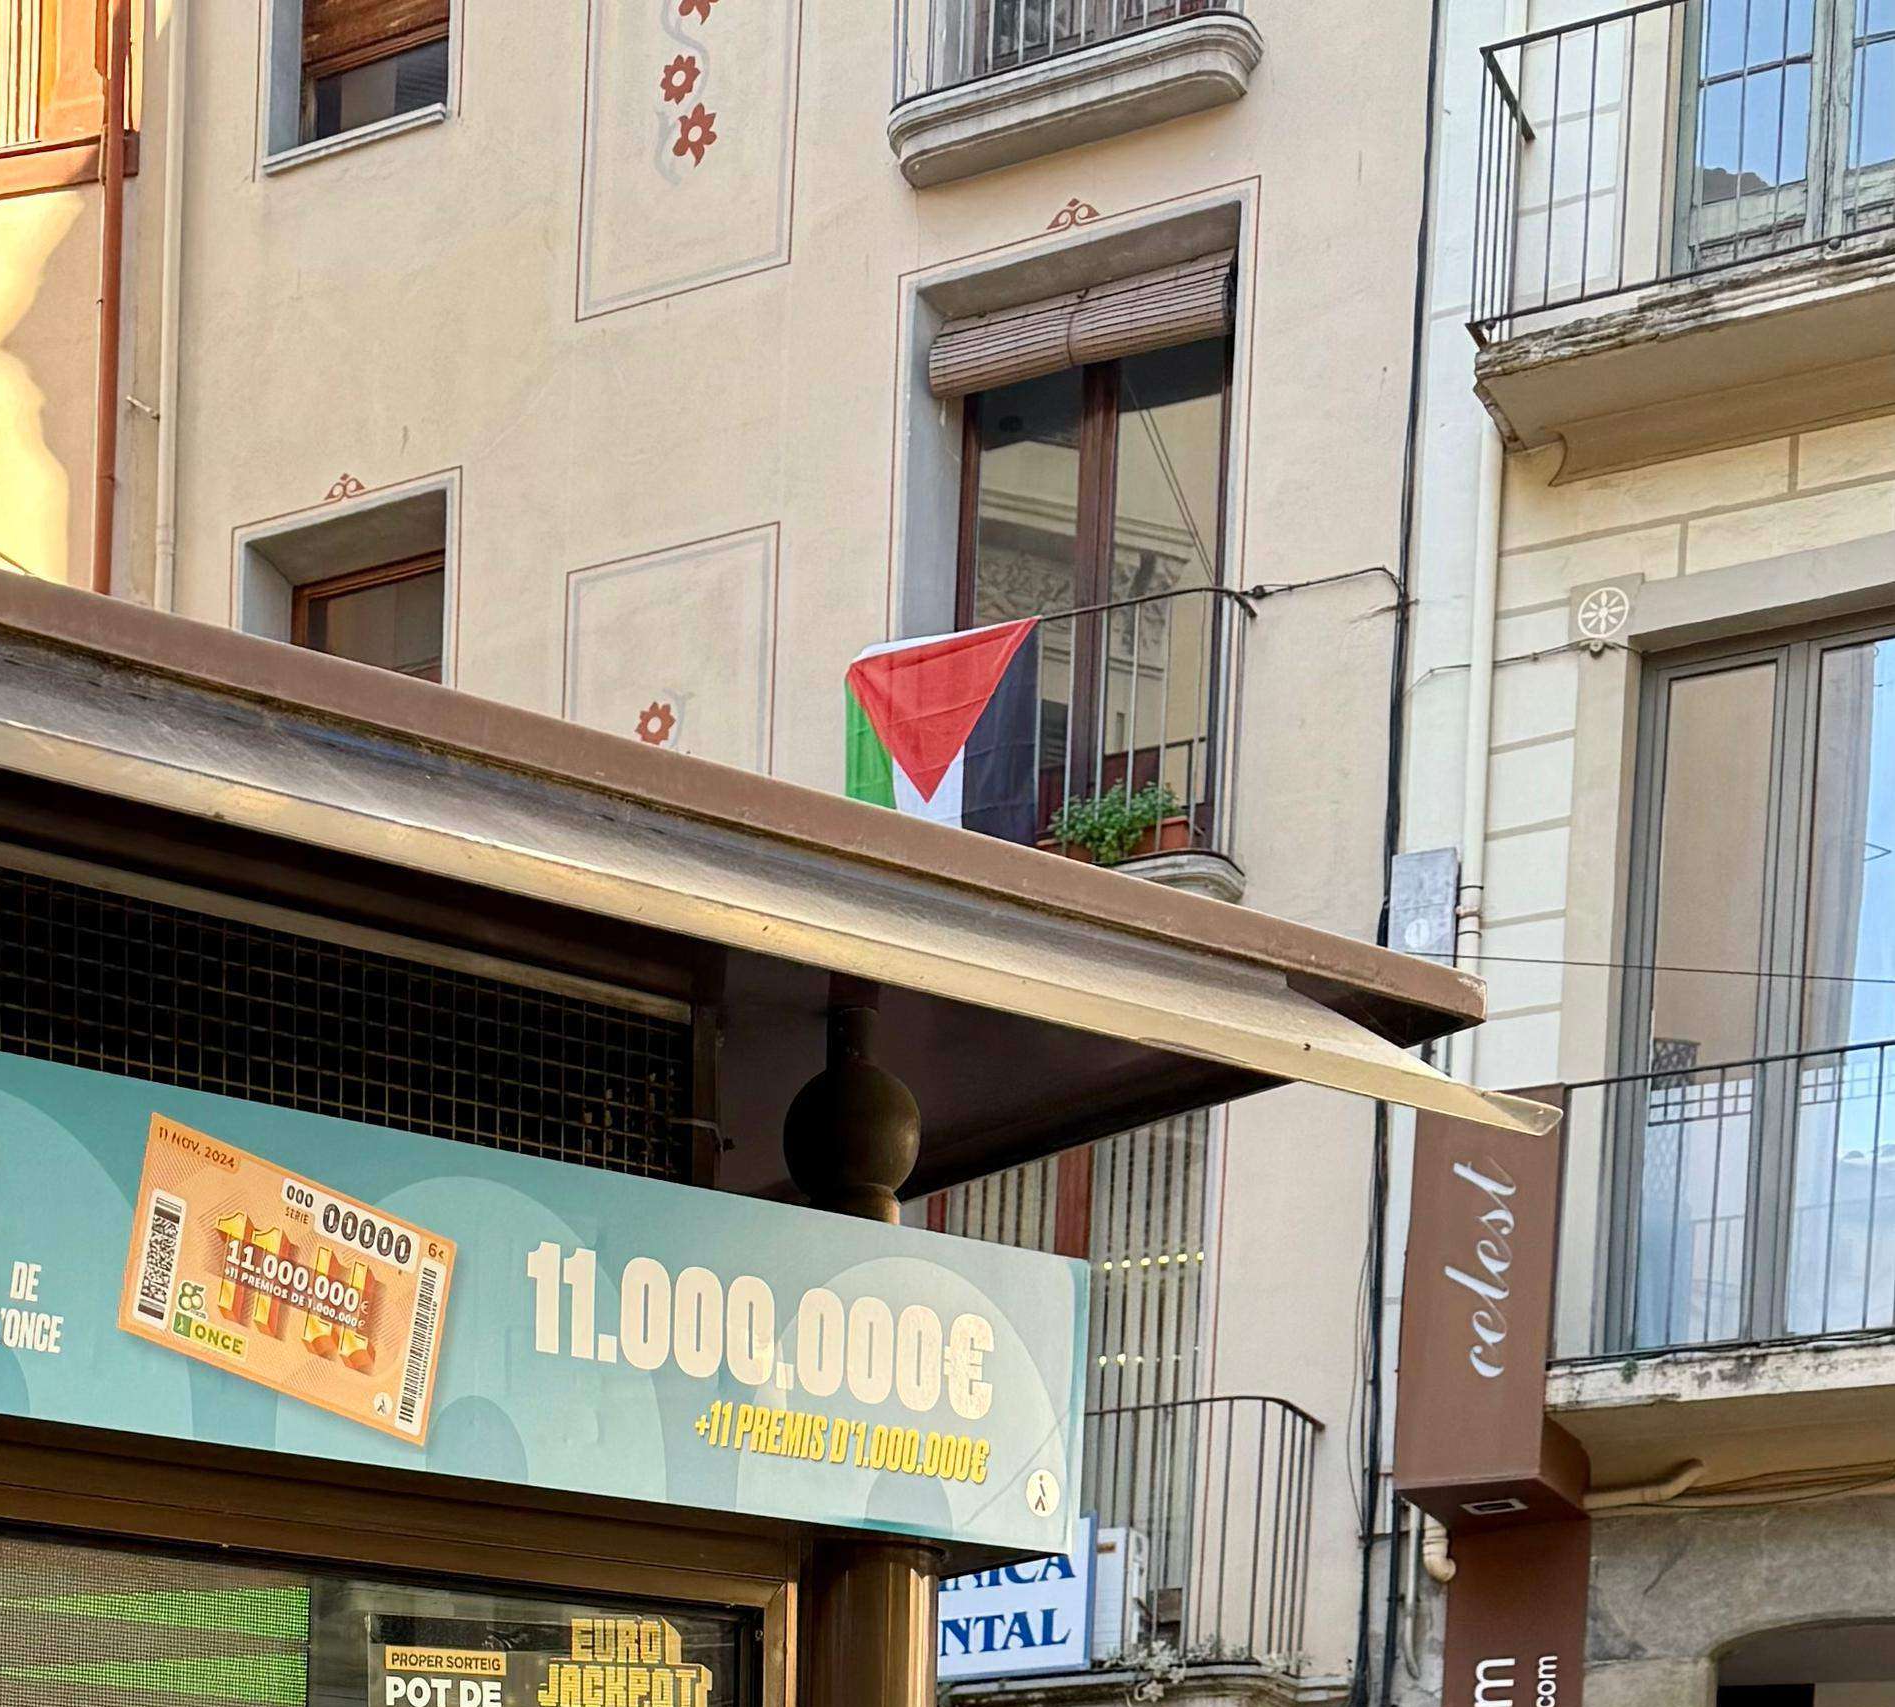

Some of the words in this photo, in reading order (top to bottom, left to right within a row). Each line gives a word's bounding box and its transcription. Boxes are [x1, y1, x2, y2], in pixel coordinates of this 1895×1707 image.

[205, 1146, 235, 1169] 2024
[286, 1185, 314, 1209] 000
[323, 1203, 412, 1264] 00000
[10, 1261, 41, 1302] DE
[242, 1272, 288, 1299] PREMIOS
[291, 1290, 304, 1305] DE
[1443, 1158, 1520, 1381] celest
[195, 1325, 243, 1354] ONCE
[527, 1241, 995, 1420] 11.000.000€
[694, 1400, 731, 1448] +11
[734, 1402, 826, 1462] PREMIS
[829, 1423, 990, 1484] D'1.000.000€
[391, 1651, 443, 1669] PROPER
[446, 1655, 501, 1672] SORTEIG
[571, 1617, 663, 1663] EURO
